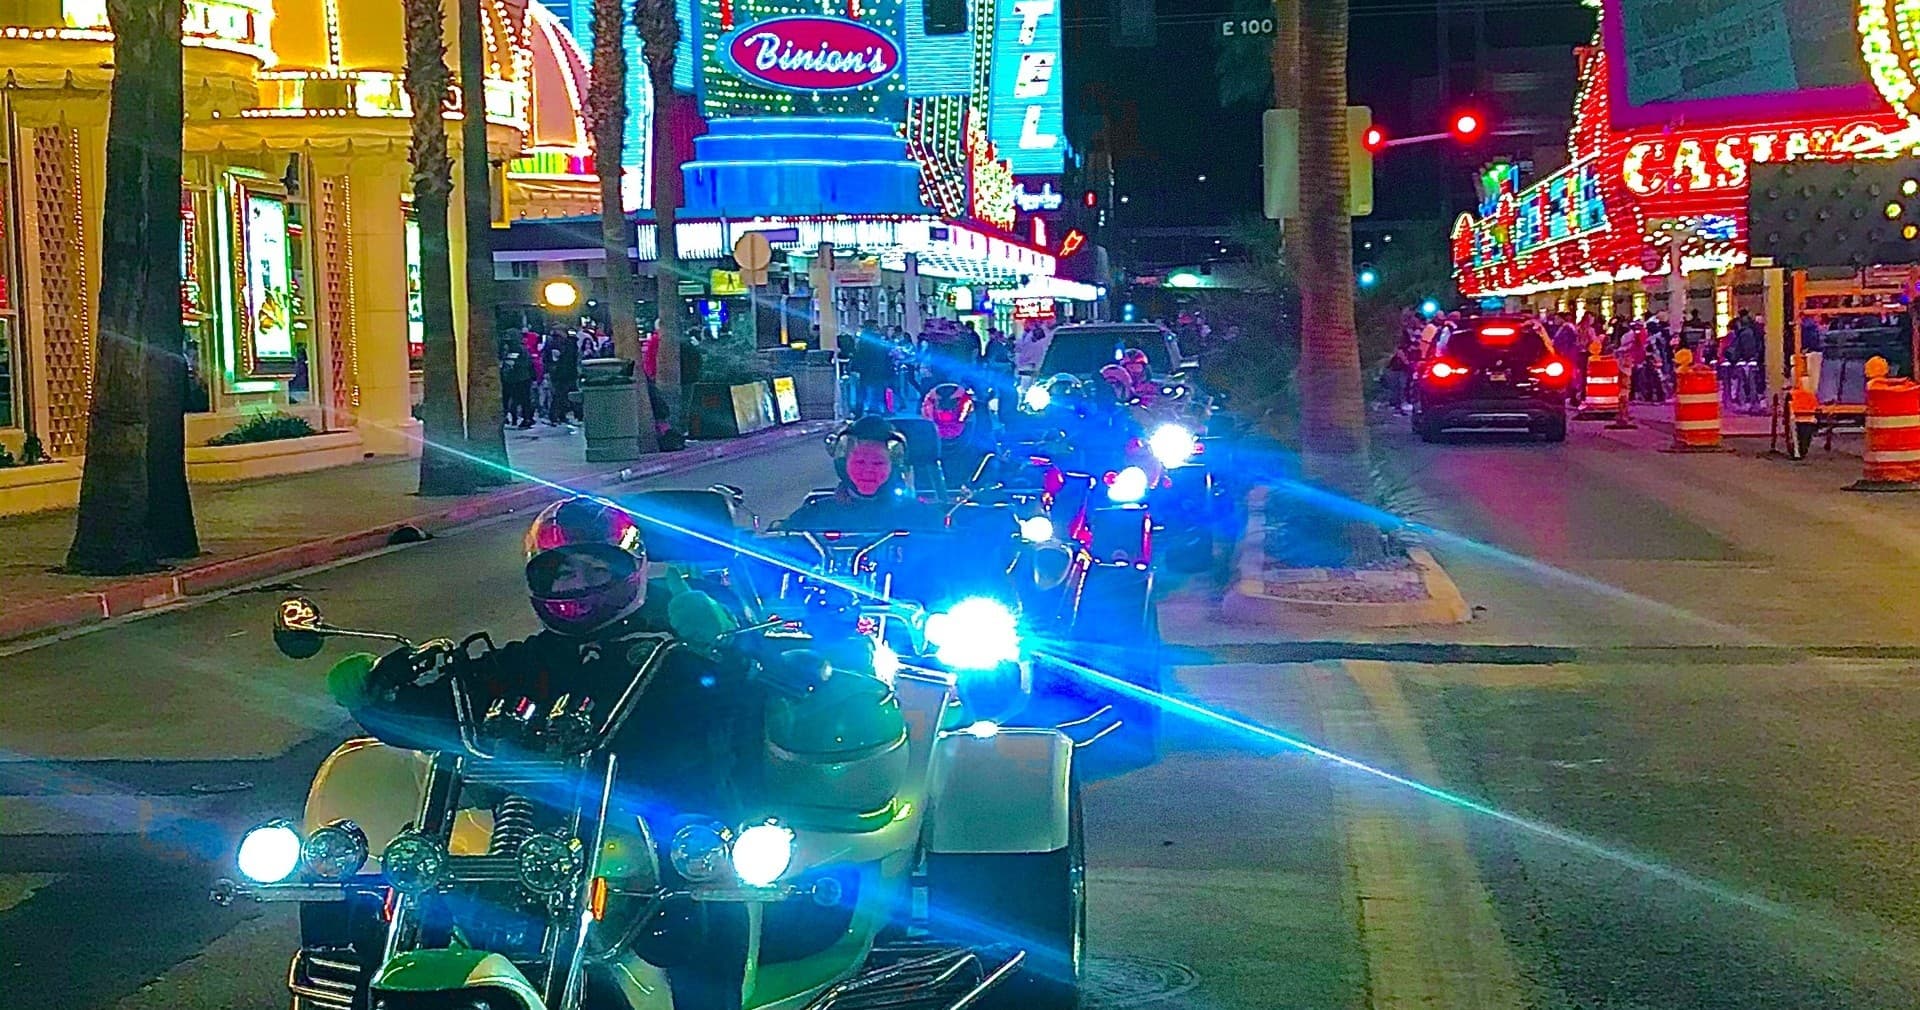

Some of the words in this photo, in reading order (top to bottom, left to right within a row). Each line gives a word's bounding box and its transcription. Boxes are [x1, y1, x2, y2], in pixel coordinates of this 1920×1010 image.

[1223, 21, 1234, 36] E
[1240, 19, 1273, 34] 100
[743, 32, 887, 73] Binion's
[1012, 1, 1058, 150] TEL
